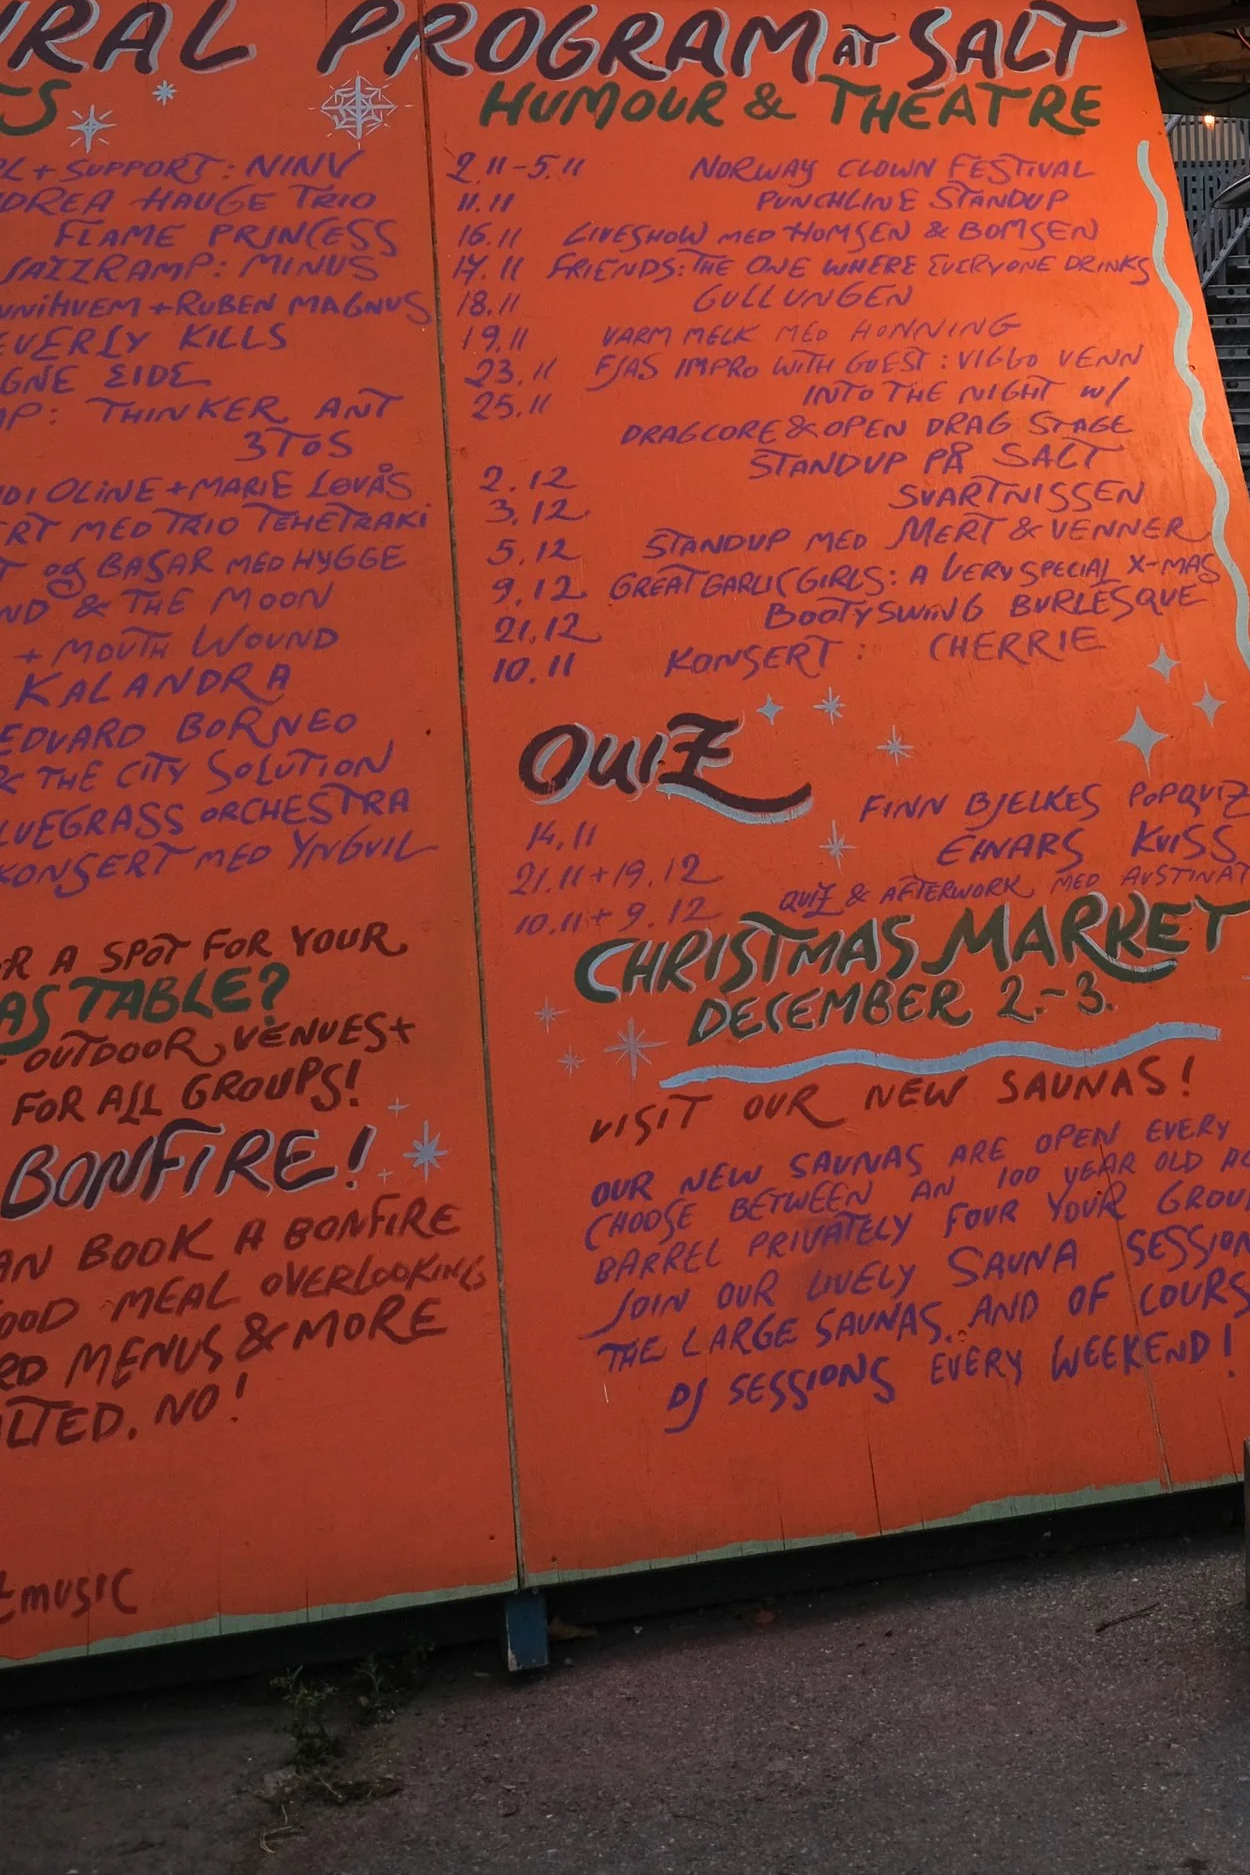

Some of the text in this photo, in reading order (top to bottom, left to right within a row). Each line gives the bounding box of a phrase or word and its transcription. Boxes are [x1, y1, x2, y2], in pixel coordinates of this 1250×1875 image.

[833, 24, 900, 68] AT
[909, 0, 1127, 91] SALT
[480, 75, 1102, 135] HUMOUR & THEATRE
[691, 153, 1096, 187] NORWAY CLOWN FESTIVAL
[288, 184, 377, 211] TRIO
[757, 180, 1070, 212] PUNCHLINE STANDUP
[54, 216, 397, 257] FLAME PRINCESS
[239, 252, 379, 282] MINUS
[745, 256, 1151, 285] ONE WHERE DRINKS
[289, 290, 432, 325] MAGNUS
[179, 323, 288, 352] KILLS
[603, 314, 1021, 347] VARM HONNING
[674, 344, 1144, 379] IMPRO VENN
[86, 396, 289, 424] THINKER
[313, 388, 403, 420] ANT
[803, 375, 1066, 406] INTO THE NIGHT
[927, 411, 1133, 438] DRAG STAGE
[749, 437, 1124, 480] STANDUP SALT
[888, 475, 1145, 512] SVARTNISSEN
[153, 508, 240, 536] TRIO
[643, 528, 791, 560] STANDUP
[1052, 516, 1212, 543] VENNER
[97, 545, 407, 583] BASAR HYGGE
[1022, 558, 1121, 589] SPECIAL
[121, 582, 334, 615] THE MOON
[1010, 583, 1209, 622] BURLESQUE
[51, 624, 339, 666] MOUTH WOUND
[929, 627, 1106, 665] CHERRIE
[14, 663, 292, 711] KALANDRA
[176, 706, 357, 749] BORNEO
[37, 738, 394, 794] THE SOLUTION
[200, 783, 410, 824] ORCHESTRA
[860, 783, 1102, 830] FINN BJELKES
[879, 875, 1035, 904] AFTERWORK
[101, 921, 409, 973] SPOT YOUR
[574, 911, 920, 1003] CHRISTMAS
[69, 961, 291, 1026] TABLE?
[687, 978, 974, 1046] DECEMBER
[24, 1027, 227, 1074] OUTDOOR
[12, 1058, 362, 1126] FOR ALL GROUPS!
[590, 1055, 1195, 1146] VISIT OUR NEW SAUNAS!
[591, 1113, 1231, 1208] OUR NEW SAUNAS ARE OPEN EVERY
[585, 1198, 697, 1251] CHOOSE
[730, 1180, 873, 1223] BETWEEN
[999, 1166, 1040, 1189] 100
[1065, 1150, 1137, 1193] YEAR
[1155, 1149, 1203, 1172] OLD
[78, 1192, 462, 1273] BOOK BONFIRE
[595, 1236, 721, 1286] BARREL
[748, 1209, 913, 1260] PRIVATELY
[1047, 1180, 1128, 1223] YOUR
[111, 1251, 487, 1322] MEAL OVERLOOKING
[717, 1268, 780, 1309] OUR
[806, 1259, 917, 1301] LIVELY
[947, 1238, 1078, 1288] SAUNA
[64, 1293, 448, 1390] MENUS MORE
[596, 1272, 1115, 1373] THE LARGE AND OF
[728, 1323, 1237, 1413] SESSIONS EVERY WEEKEND!
